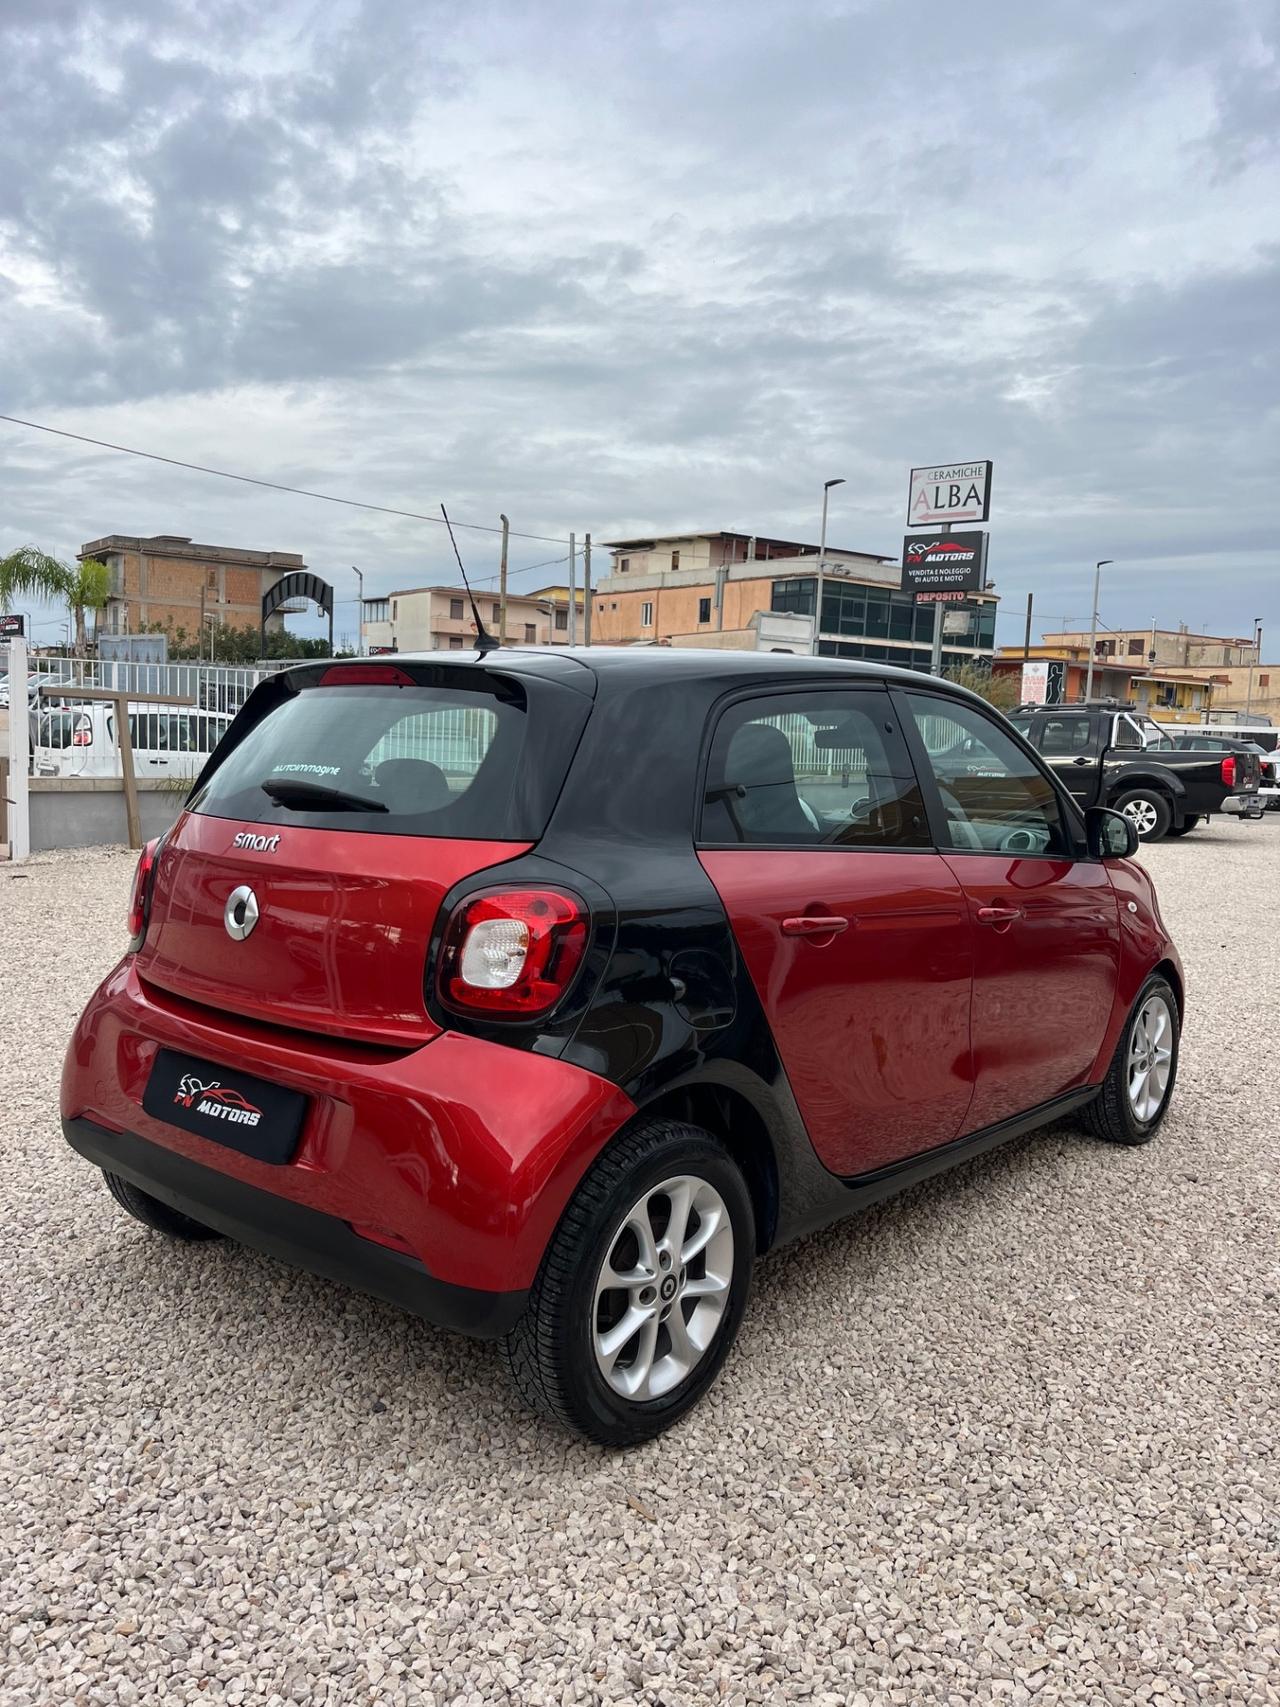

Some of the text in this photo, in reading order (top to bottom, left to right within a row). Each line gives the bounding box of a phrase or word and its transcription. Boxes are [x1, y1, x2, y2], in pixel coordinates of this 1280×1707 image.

[928, 466, 983, 480] CERAMICHE
[912, 483, 982, 511] ALBA
[925, 552, 975, 562] MOTORS
[939, 567, 972, 575] NOLEGGIO
[916, 592, 965, 602] DEPOSITO
[233, 832, 280, 852] smart
[174, 1092, 261, 1126] FN MOTORS
